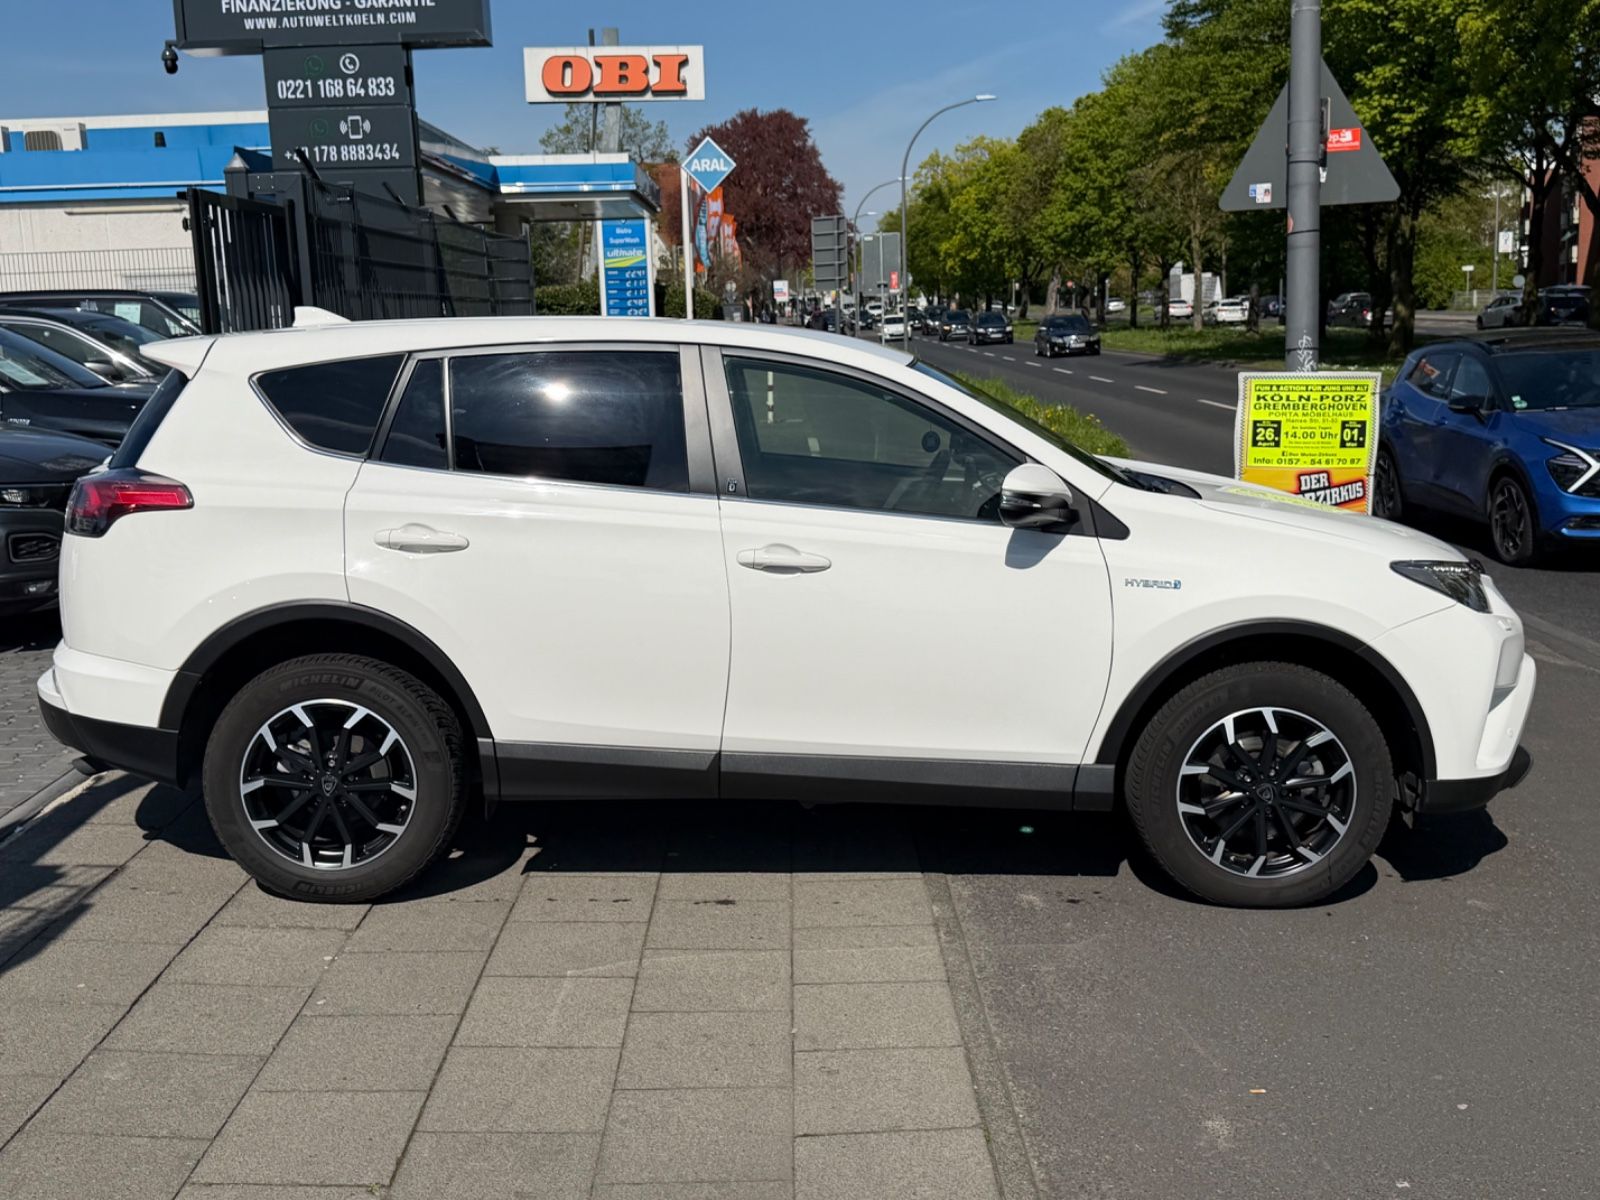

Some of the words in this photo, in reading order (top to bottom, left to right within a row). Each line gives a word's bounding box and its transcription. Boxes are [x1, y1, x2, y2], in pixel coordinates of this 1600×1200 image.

[221, 0, 342, 14] FINANZIERUNG
[243, 11, 417, 30] WWW.AUTOWELTKOELN.COM
[542, 54, 689, 94] OBI
[277, 79, 313, 99] 0221
[317, 78, 344, 98] 168
[346, 78, 366, 97] 64
[368, 76, 396, 97] 833
[313, 145, 338, 162] 178
[340, 143, 400, 162] 8883434
[691, 158, 729, 172] ARAL
[1256, 393, 1367, 402] KÖLN-PORZ
[1254, 402, 1367, 411] GREMBERGHOVEN
[1256, 427, 1279, 441] 26.
[1284, 431, 1316, 440] 14.00
[1320, 431, 1339, 440] Uhr
[1343, 428, 1364, 442] 01.
[1254, 457, 1274, 465] Info:
[1276, 458, 1300, 466] 0157
[1300, 472, 1329, 491] DER
[279, 674, 361, 692] MICHELIN
